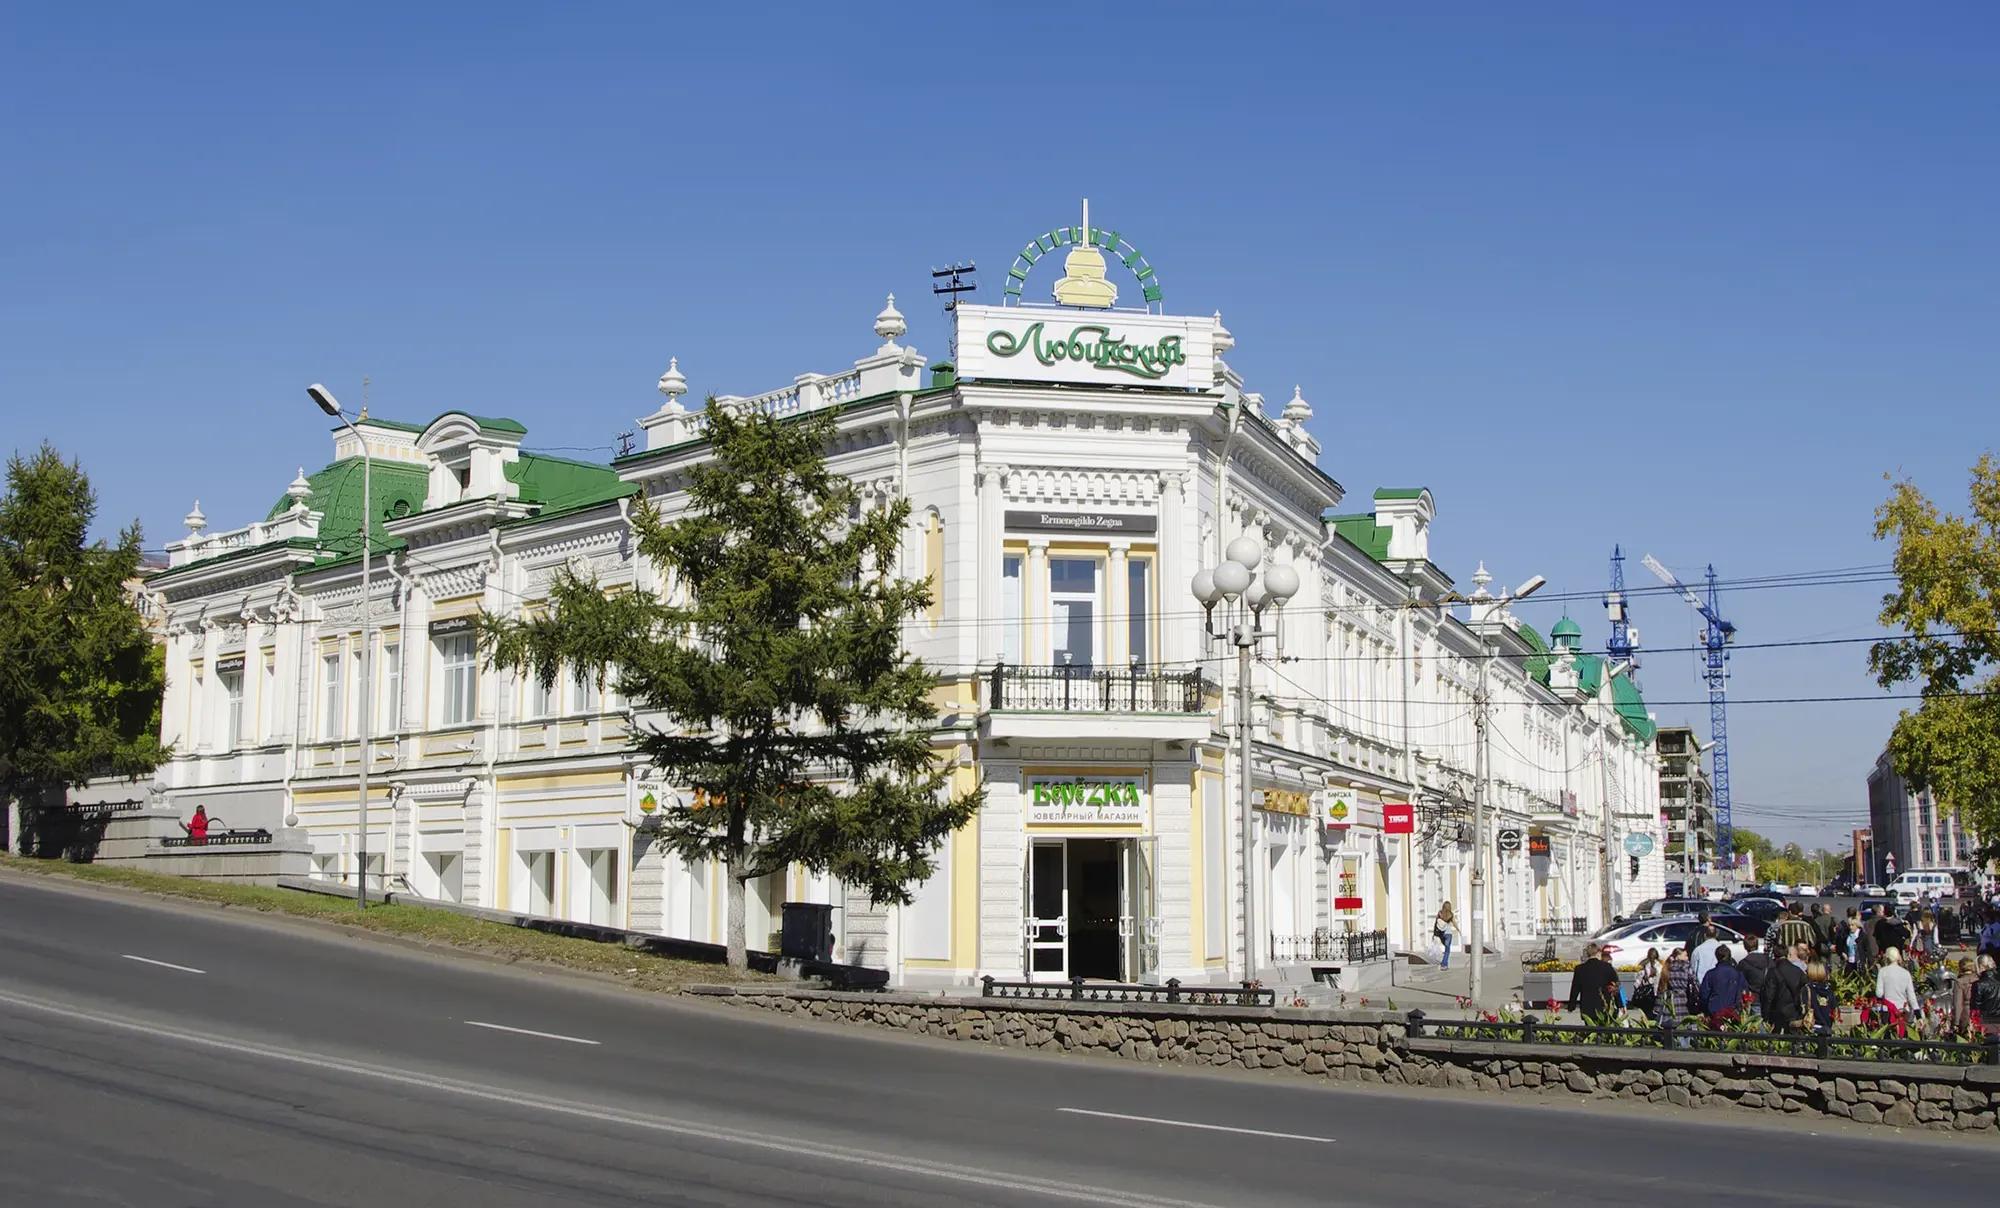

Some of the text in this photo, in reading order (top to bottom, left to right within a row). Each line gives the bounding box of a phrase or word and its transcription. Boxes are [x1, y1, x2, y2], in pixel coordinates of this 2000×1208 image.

[986, 322, 1186, 379] Любинский
[1040, 514, 1122, 528] Ermenegildo Zegna
[1033, 811, 1139, 821] ЮВЕЛИРНЫЙ МАГАЗИН
